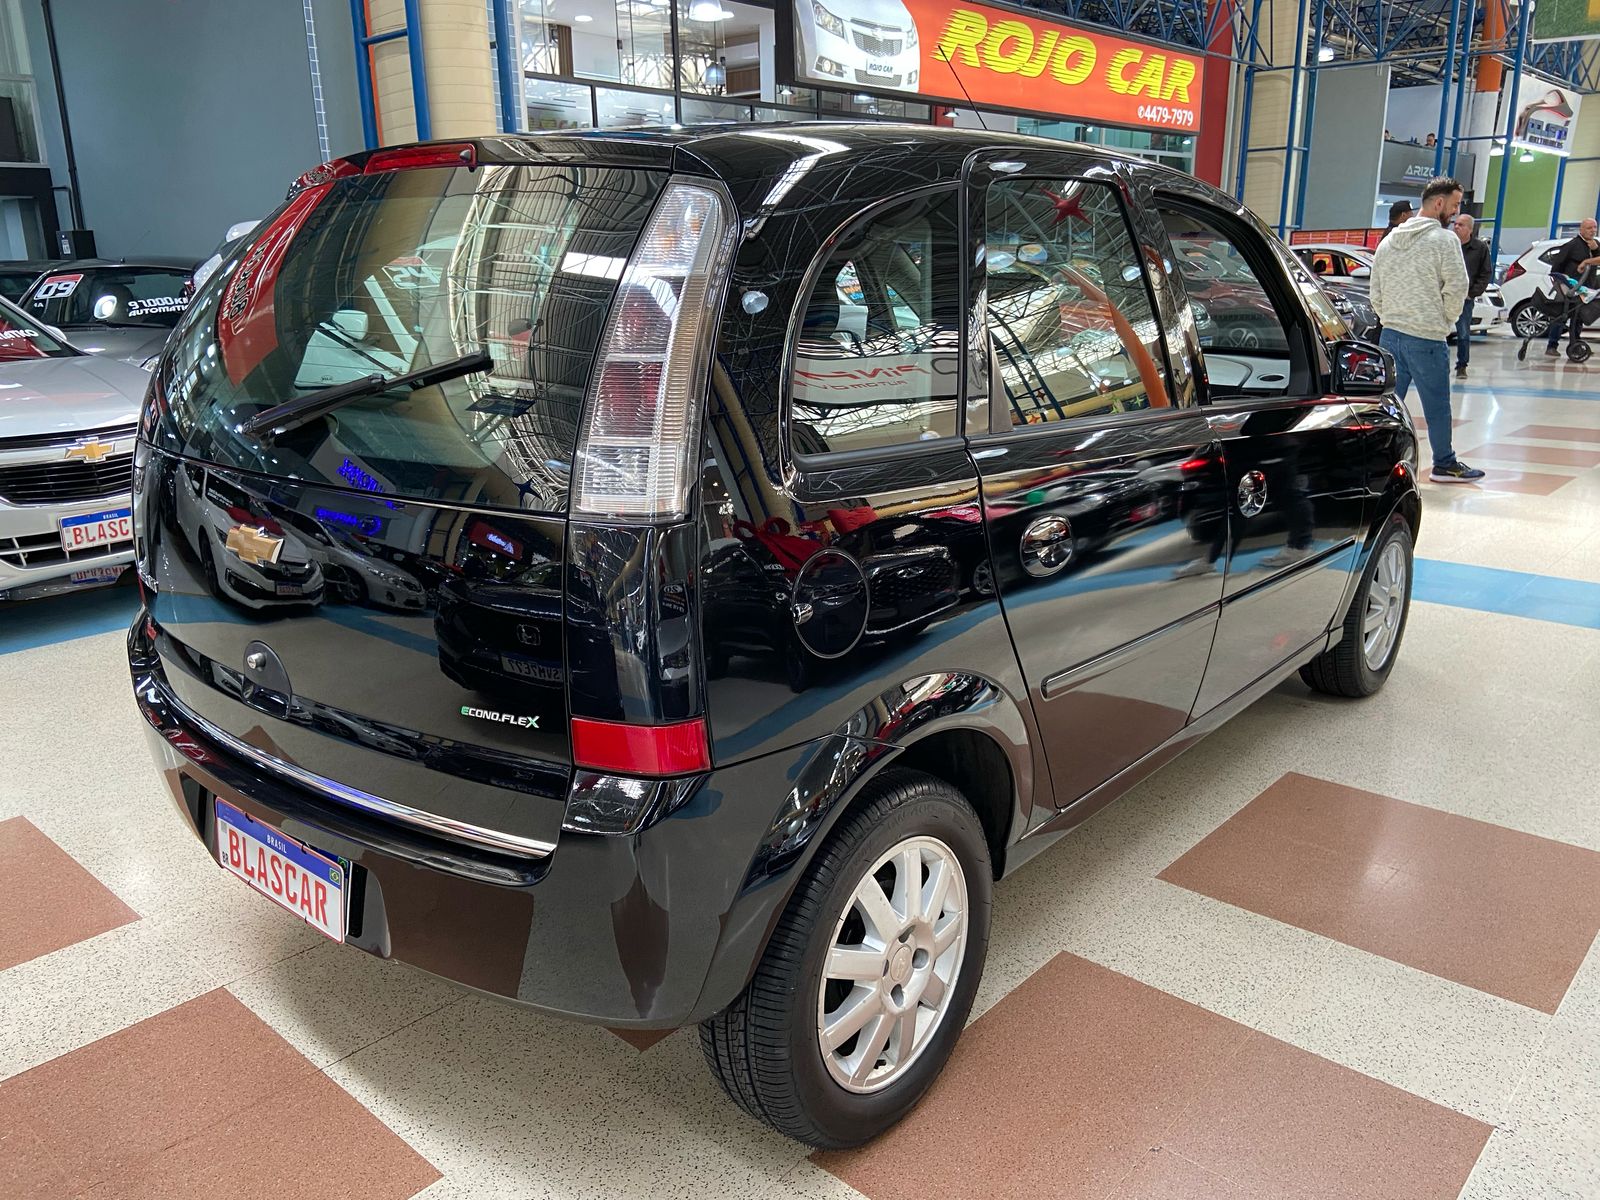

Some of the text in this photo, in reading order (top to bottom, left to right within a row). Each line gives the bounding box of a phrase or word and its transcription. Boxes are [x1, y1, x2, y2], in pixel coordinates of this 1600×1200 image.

[930, 9, 1196, 104] ROJO CAR
[1144, 105, 1194, 127] 4479-7979
[1405, 164, 1449, 178] ARIZOA
[36, 281, 76, 299] 09
[266, 834, 287, 854] BRASIL
[228, 829, 328, 926] BLASCAR
